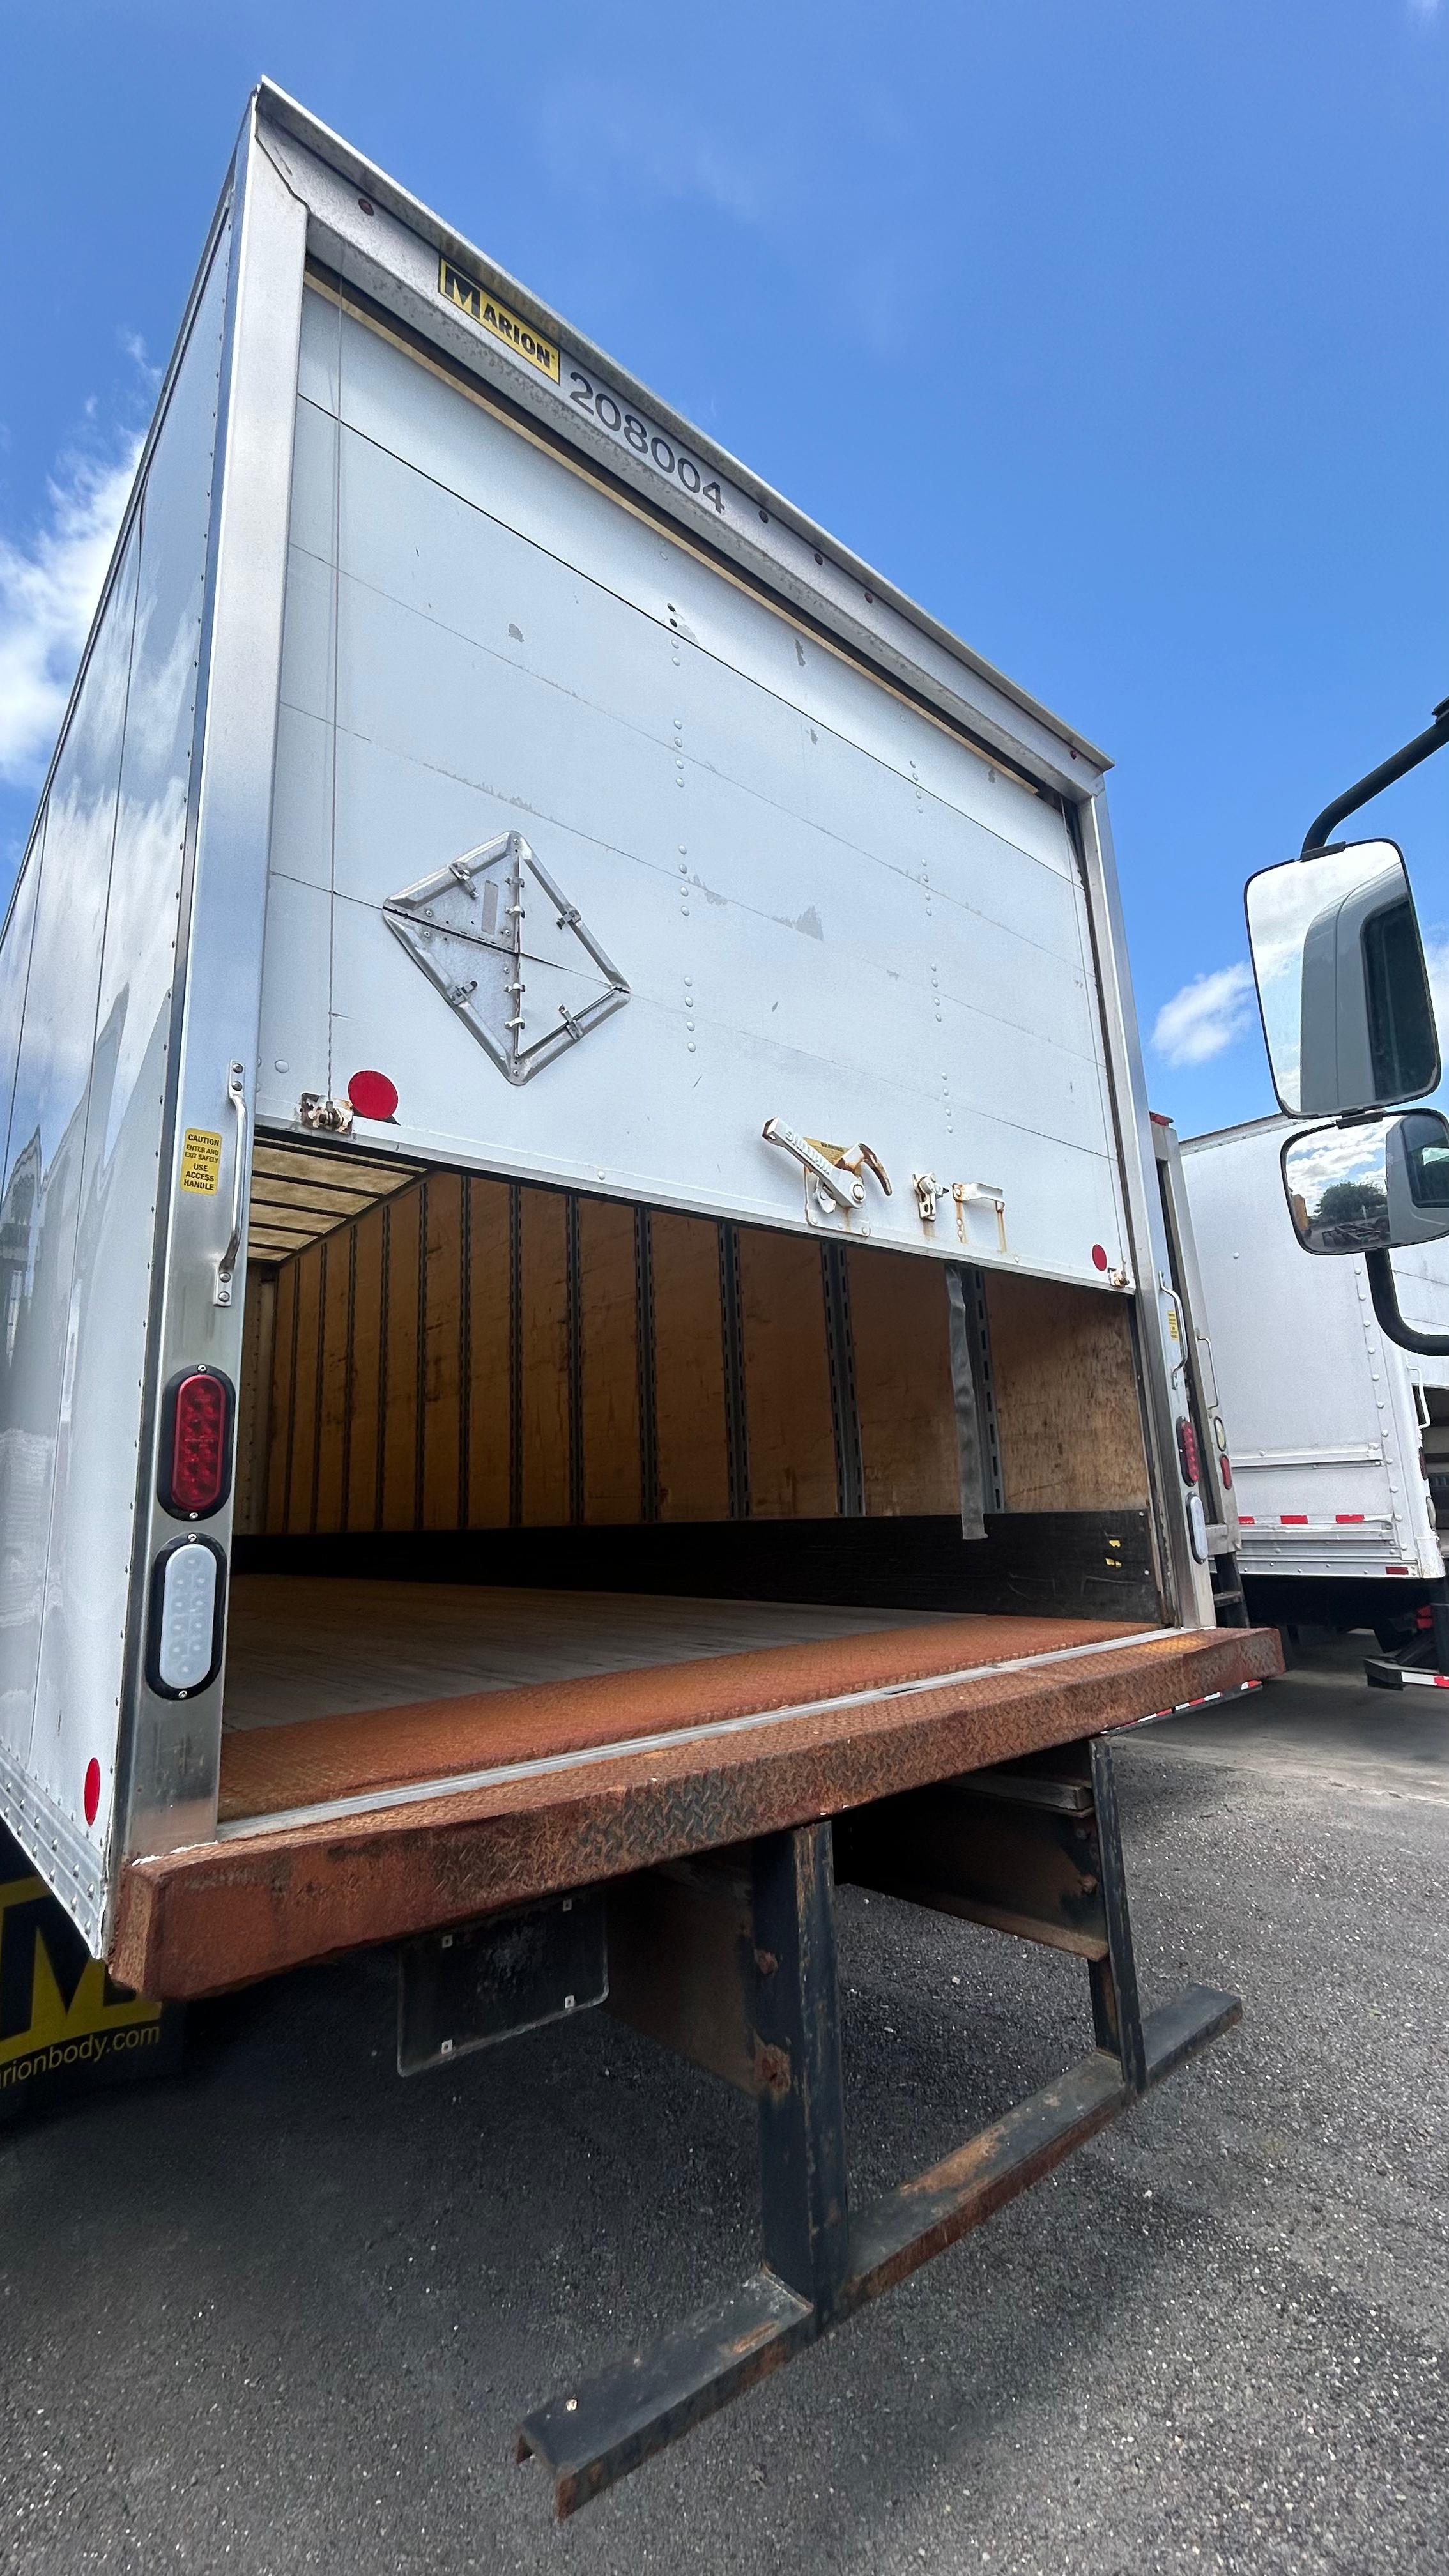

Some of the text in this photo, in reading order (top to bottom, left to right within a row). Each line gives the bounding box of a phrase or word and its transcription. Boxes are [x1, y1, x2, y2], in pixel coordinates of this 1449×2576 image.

[444, 264, 553, 371] MARION
[569, 371, 726, 514] 208004
[188, 1133, 220, 1146] CAUTION
[186, 1144, 205, 1153] ENTER
[198, 1154, 218, 1163] SAFELY
[194, 1163, 208, 1172] USE
[185, 1170, 215, 1182] ACCESS
[184, 1179, 214, 1191] HANDLE
[0, 2026, 160, 2089] rionbody.com
